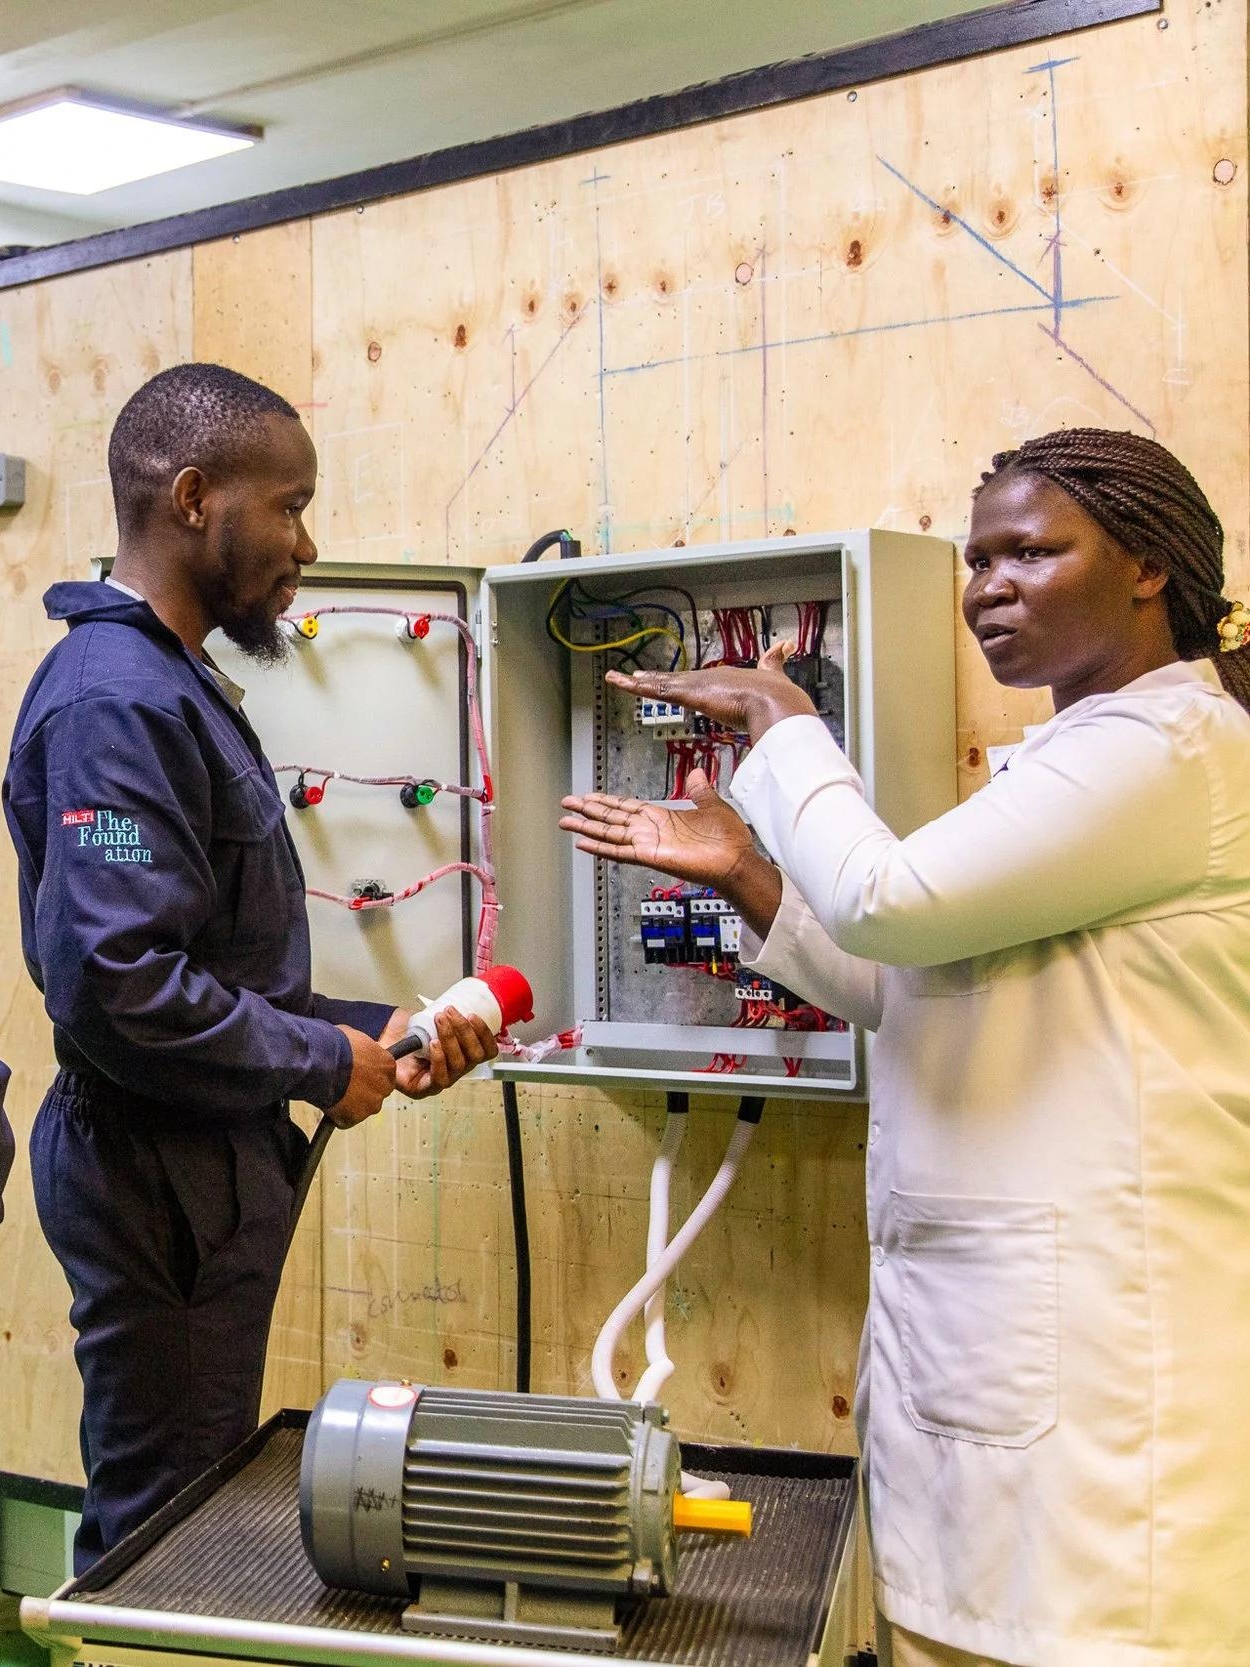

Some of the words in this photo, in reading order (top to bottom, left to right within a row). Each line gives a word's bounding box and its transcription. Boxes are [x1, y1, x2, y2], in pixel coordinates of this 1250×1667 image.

[61, 810, 95, 825] HILTI
[96, 810, 133, 832] The
[77, 824, 142, 847] Found
[104, 846, 153, 863] ation
